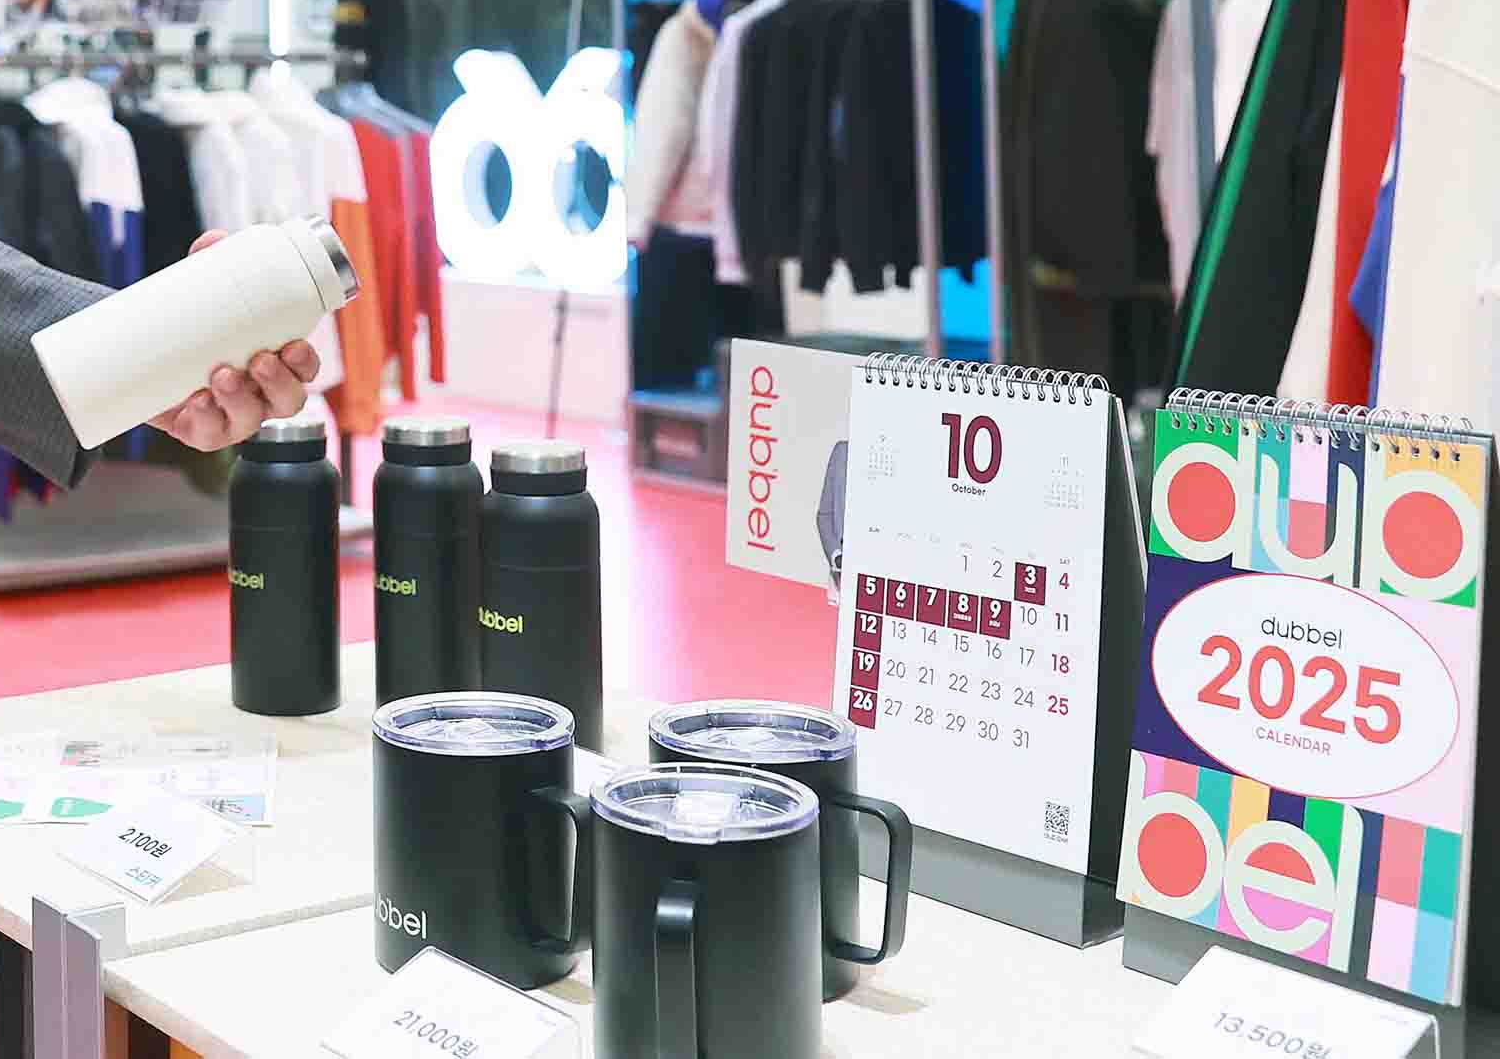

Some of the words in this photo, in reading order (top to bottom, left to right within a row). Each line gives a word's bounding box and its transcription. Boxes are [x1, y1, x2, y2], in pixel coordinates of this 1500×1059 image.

[748, 366, 780, 551] dubbel
[941, 412, 1002, 484] 10
[951, 483, 986, 497] October
[963, 555, 968, 572] 1
[993, 561, 1002, 578] 2
[1025, 566, 1036, 584] 3
[1059, 573, 1069, 589] 4
[866, 577, 876, 594] 5
[895, 583, 906, 600] 6
[927, 589, 937, 605] 7
[958, 594, 969, 613] 8
[990, 600, 1002, 618] 9
[1020, 606, 1037, 625] 10
[1055, 613, 1069, 631] 11
[860, 616, 877, 633] 12
[891, 621, 906, 639] 13
[921, 627, 937, 645] 14
[953, 634, 969, 653] 15
[985, 640, 1002, 659] 16
[1020, 647, 1035, 667] 17
[1052, 654, 1069, 673] 18
[1261, 617, 1342, 649] dubbel
[857, 653, 875, 671] 19
[886, 659, 905, 678] 20
[918, 667, 934, 685] 21
[949, 673, 968, 693] 22
[981, 680, 1000, 700] 23
[1014, 688, 1034, 707] 24
[1048, 695, 1068, 715] 25
[1197, 635, 1401, 744] 2025
[853, 692, 873, 710] 26
[884, 699, 902, 716] 27
[915, 706, 933, 724] 28
[946, 713, 966, 732] 29
[978, 721, 998, 740] 30
[1013, 729, 1029, 748] 31
[1255, 727, 1331, 756] CALENDAR
[118, 828, 172, 858] 2,100원
[377, 895, 427, 939] bbel
